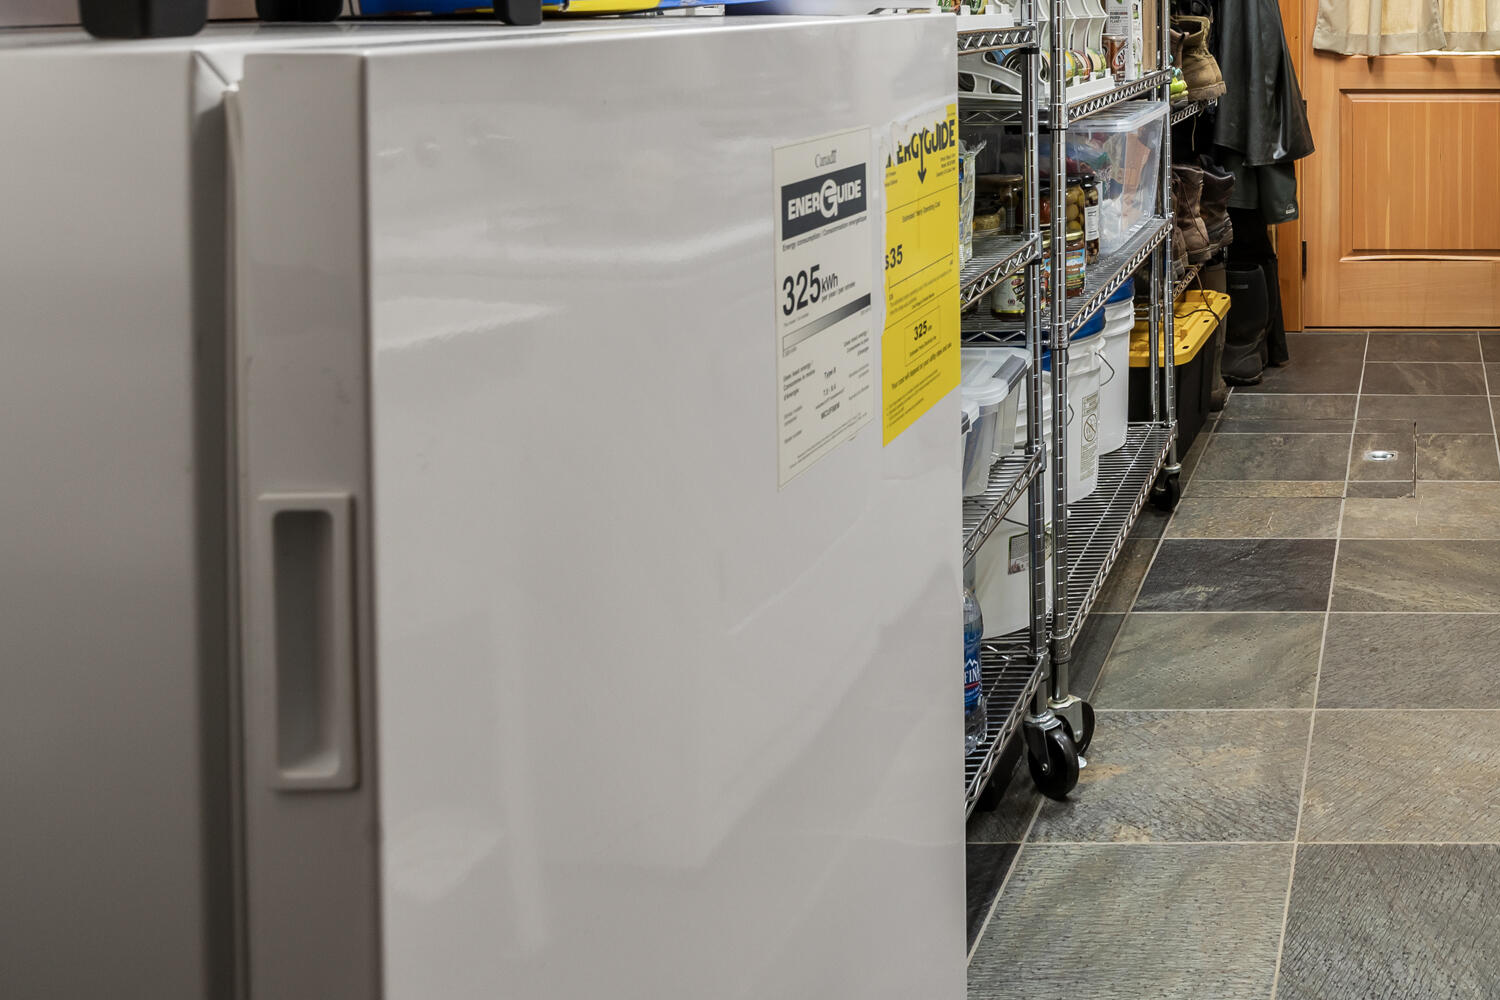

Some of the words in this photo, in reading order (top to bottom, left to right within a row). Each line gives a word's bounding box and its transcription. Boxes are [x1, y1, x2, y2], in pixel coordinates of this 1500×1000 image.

[787, 178, 862, 221] ENERGUIDE
[782, 263, 821, 317] 325
[821, 272, 839, 294] kWh
[914, 319, 928, 341] 325
